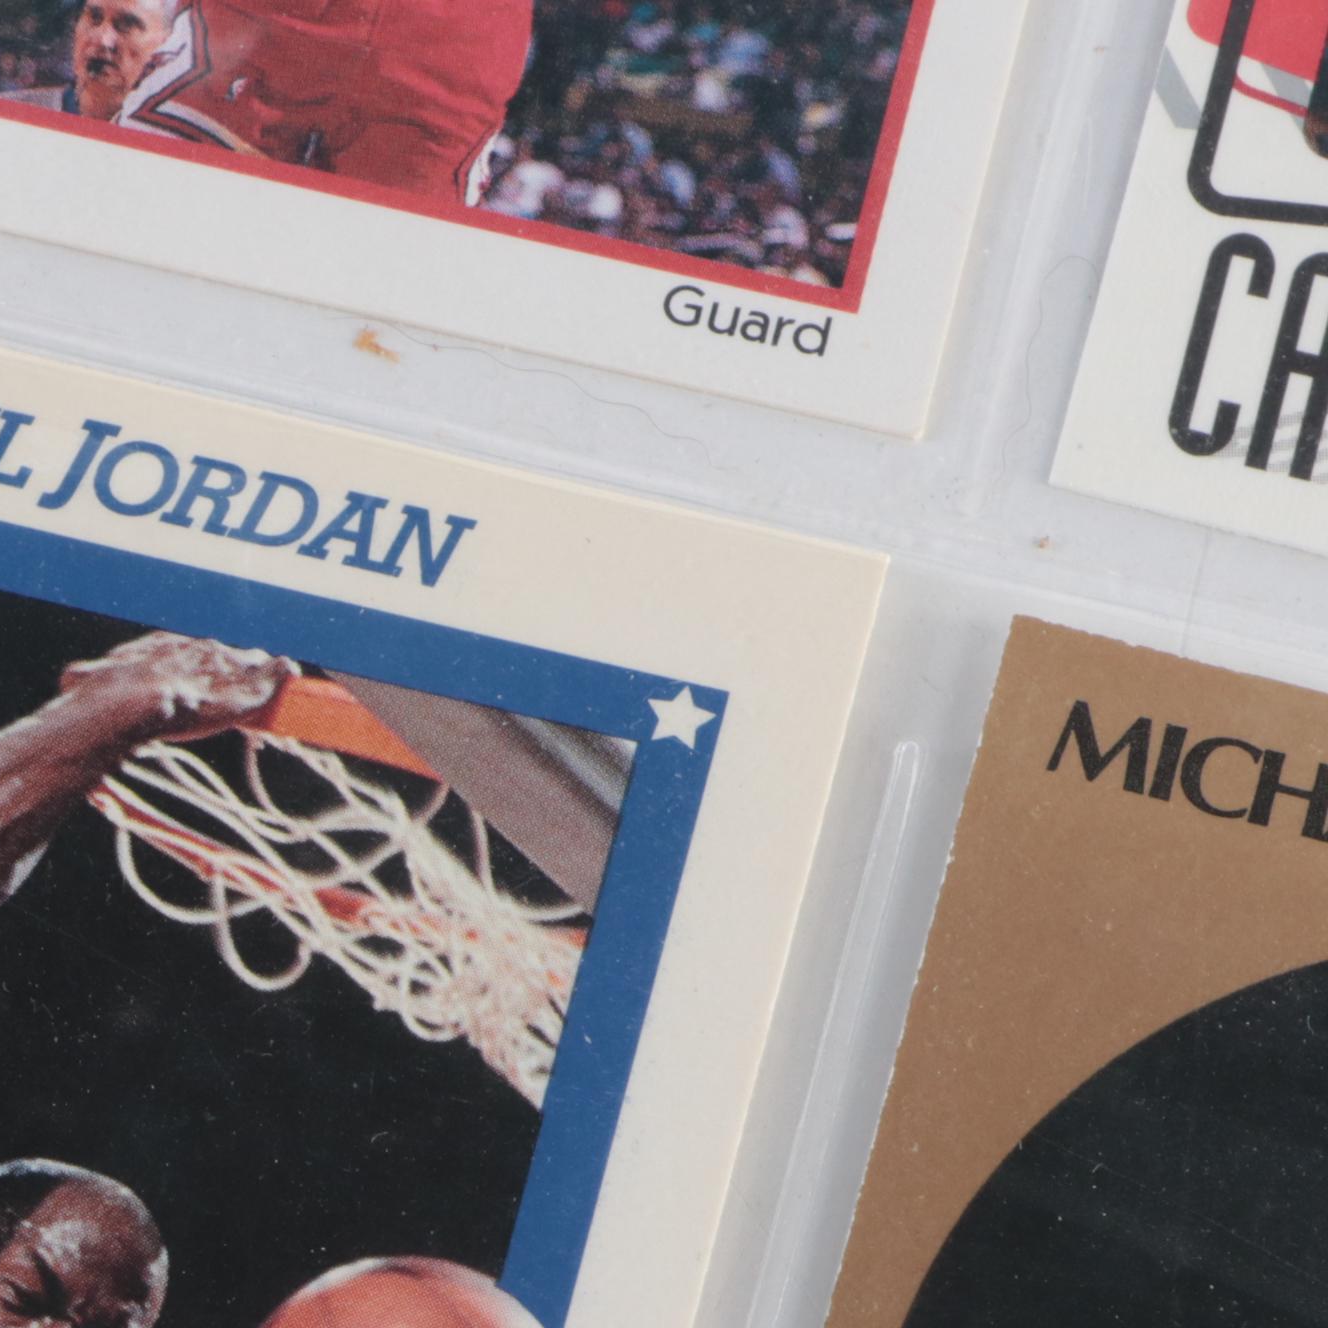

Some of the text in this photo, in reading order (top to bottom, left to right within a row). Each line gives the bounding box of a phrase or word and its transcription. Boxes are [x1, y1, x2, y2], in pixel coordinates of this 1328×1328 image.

[661, 283, 833, 358] Guard
[36, 418, 478, 588] JORDAN
[1045, 699, 1328, 844] MICH
